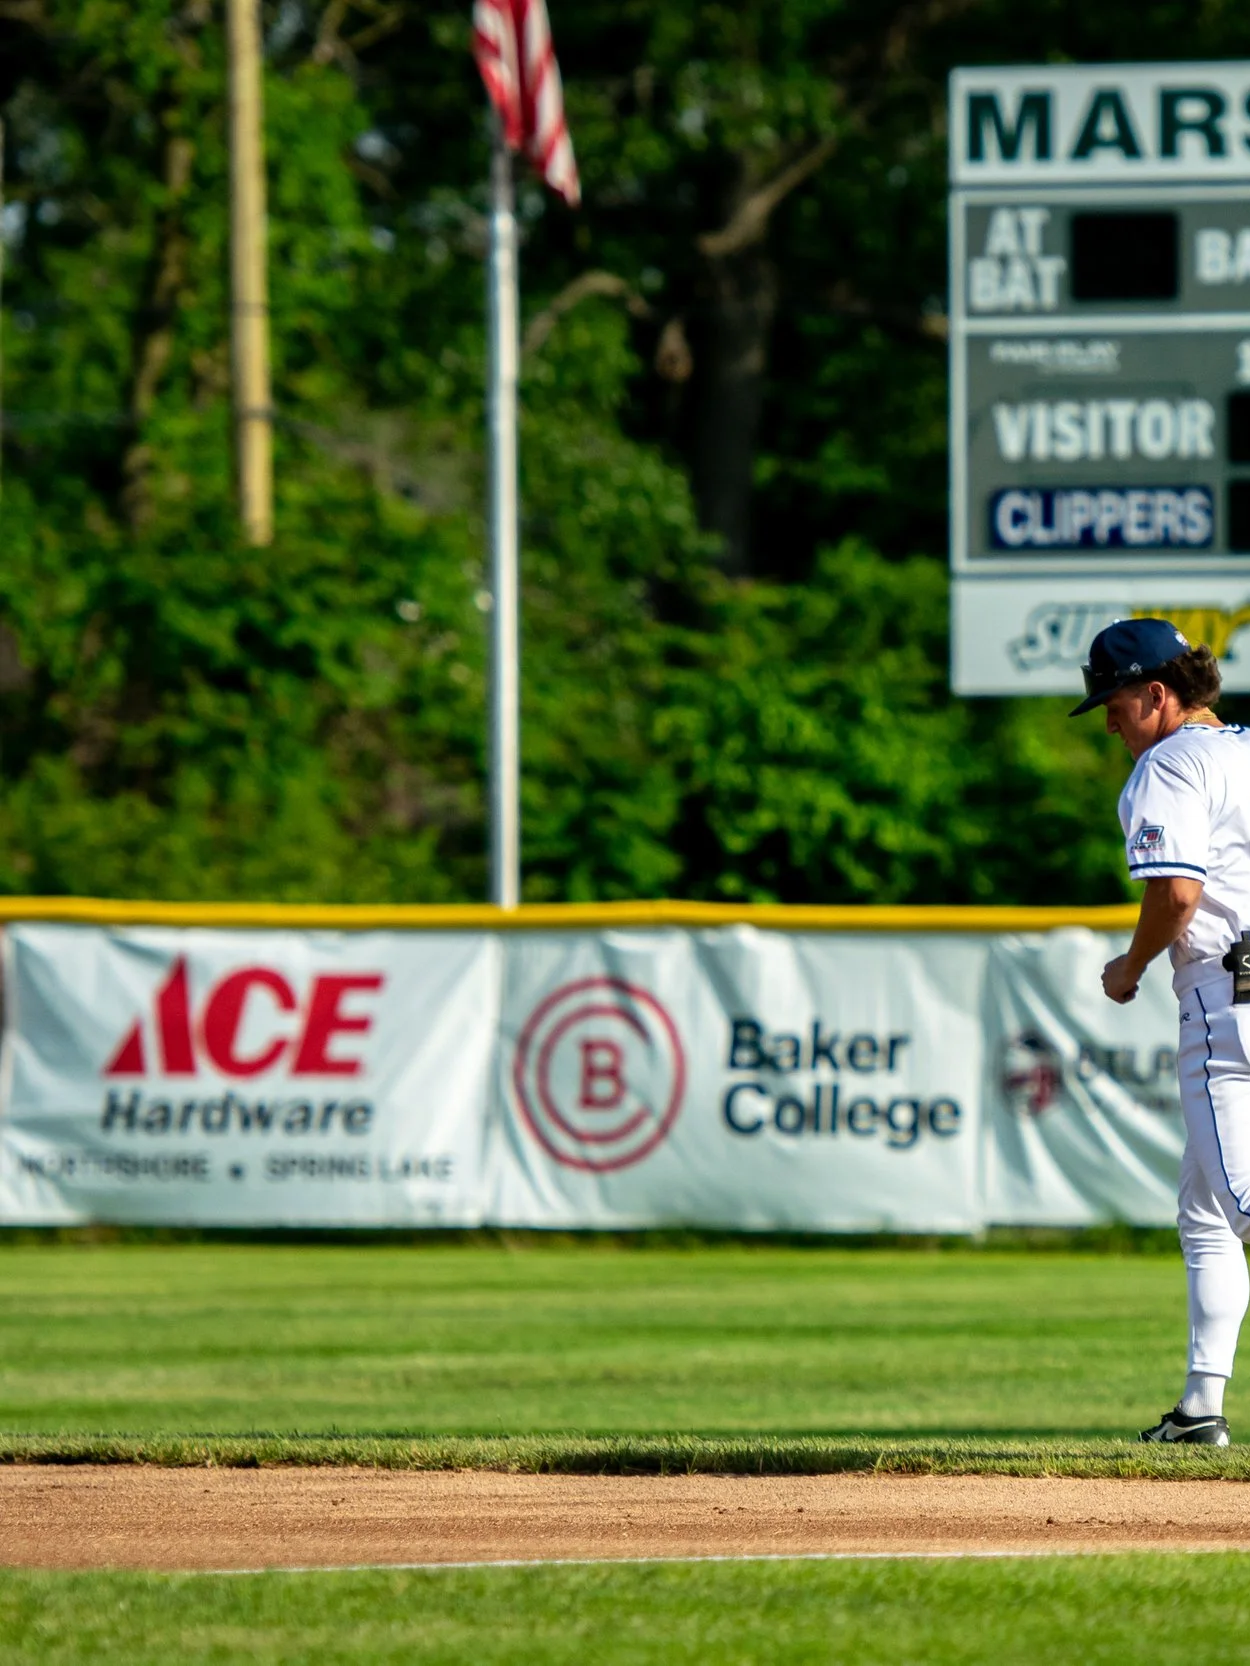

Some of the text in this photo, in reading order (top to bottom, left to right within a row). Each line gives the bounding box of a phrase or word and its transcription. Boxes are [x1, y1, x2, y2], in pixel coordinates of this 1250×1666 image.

[985, 209, 1051, 256] AT
[970, 257, 1066, 310] BAT
[993, 399, 1214, 461] VISITOR
[996, 491, 1212, 546] CLIPPERS
[103, 952, 386, 1078] ACE
[728, 1018, 909, 1073] Baker
[102, 1090, 375, 1135] Hardware
[724, 1081, 963, 1150] College
